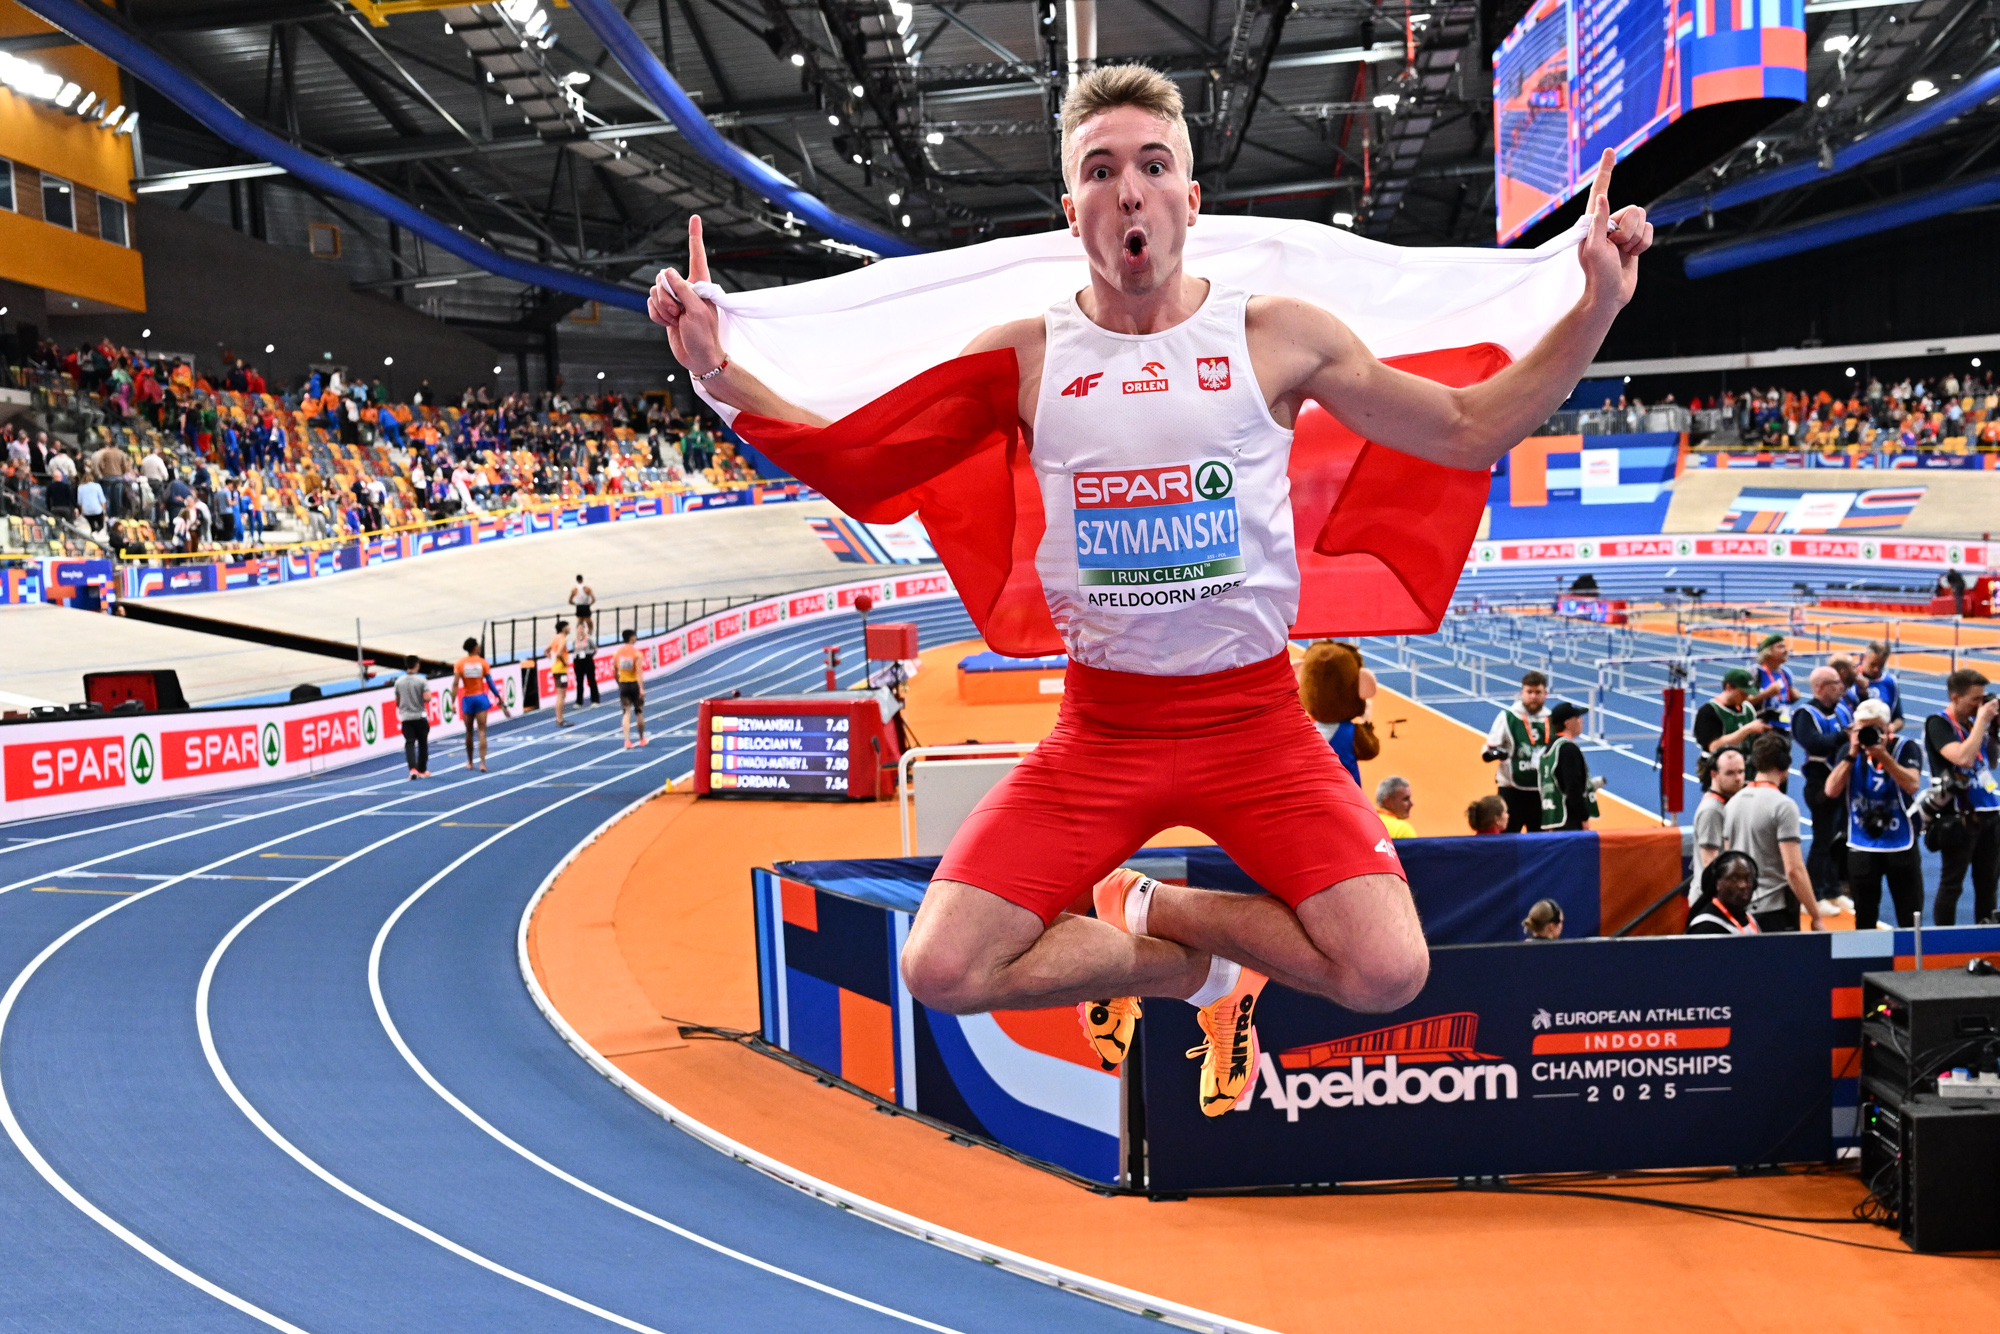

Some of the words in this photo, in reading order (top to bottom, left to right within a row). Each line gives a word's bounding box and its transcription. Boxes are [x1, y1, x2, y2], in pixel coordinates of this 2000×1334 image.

[1061, 372, 1104, 398] 4F
[1125, 381, 1166, 393] ORLEN
[1076, 471, 1189, 504] SPAR
[1077, 509, 1236, 555] SZYMANSKI
[1517, 545, 1574, 559] SPAR
[1615, 541, 1672, 555] SPAR
[1711, 540, 1767, 554] SPAR
[1805, 541, 1859, 558] SPAR
[1893, 544, 1946, 561] SPAR
[904, 576, 948, 594] SPAR
[1111, 572, 1115, 583] I
[1118, 570, 1150, 583] RUN
[795, 594, 825, 614] SPAR
[1088, 588, 1196, 607] APELDOORN
[754, 604, 779, 625] SPAR
[302, 715, 362, 753] SPAR
[184, 731, 260, 770] SPAR
[738, 737, 789, 751] BELOCIAN
[32, 743, 124, 790] SPAR
[737, 775, 778, 789] JORDAN
[1872, 777, 1884, 792] 7
[1555, 1009, 1641, 1026] EUROPEAN
[1645, 1006, 1732, 1022] ATHLETICS
[1227, 994, 1253, 1087] NITRO
[1584, 1032, 1677, 1050] INDOOR
[1531, 1055, 1732, 1082] CHAMPIONSHIPS
[1235, 1053, 1518, 1122] Apeldoorn
[1587, 1082, 1677, 1102] 2025
